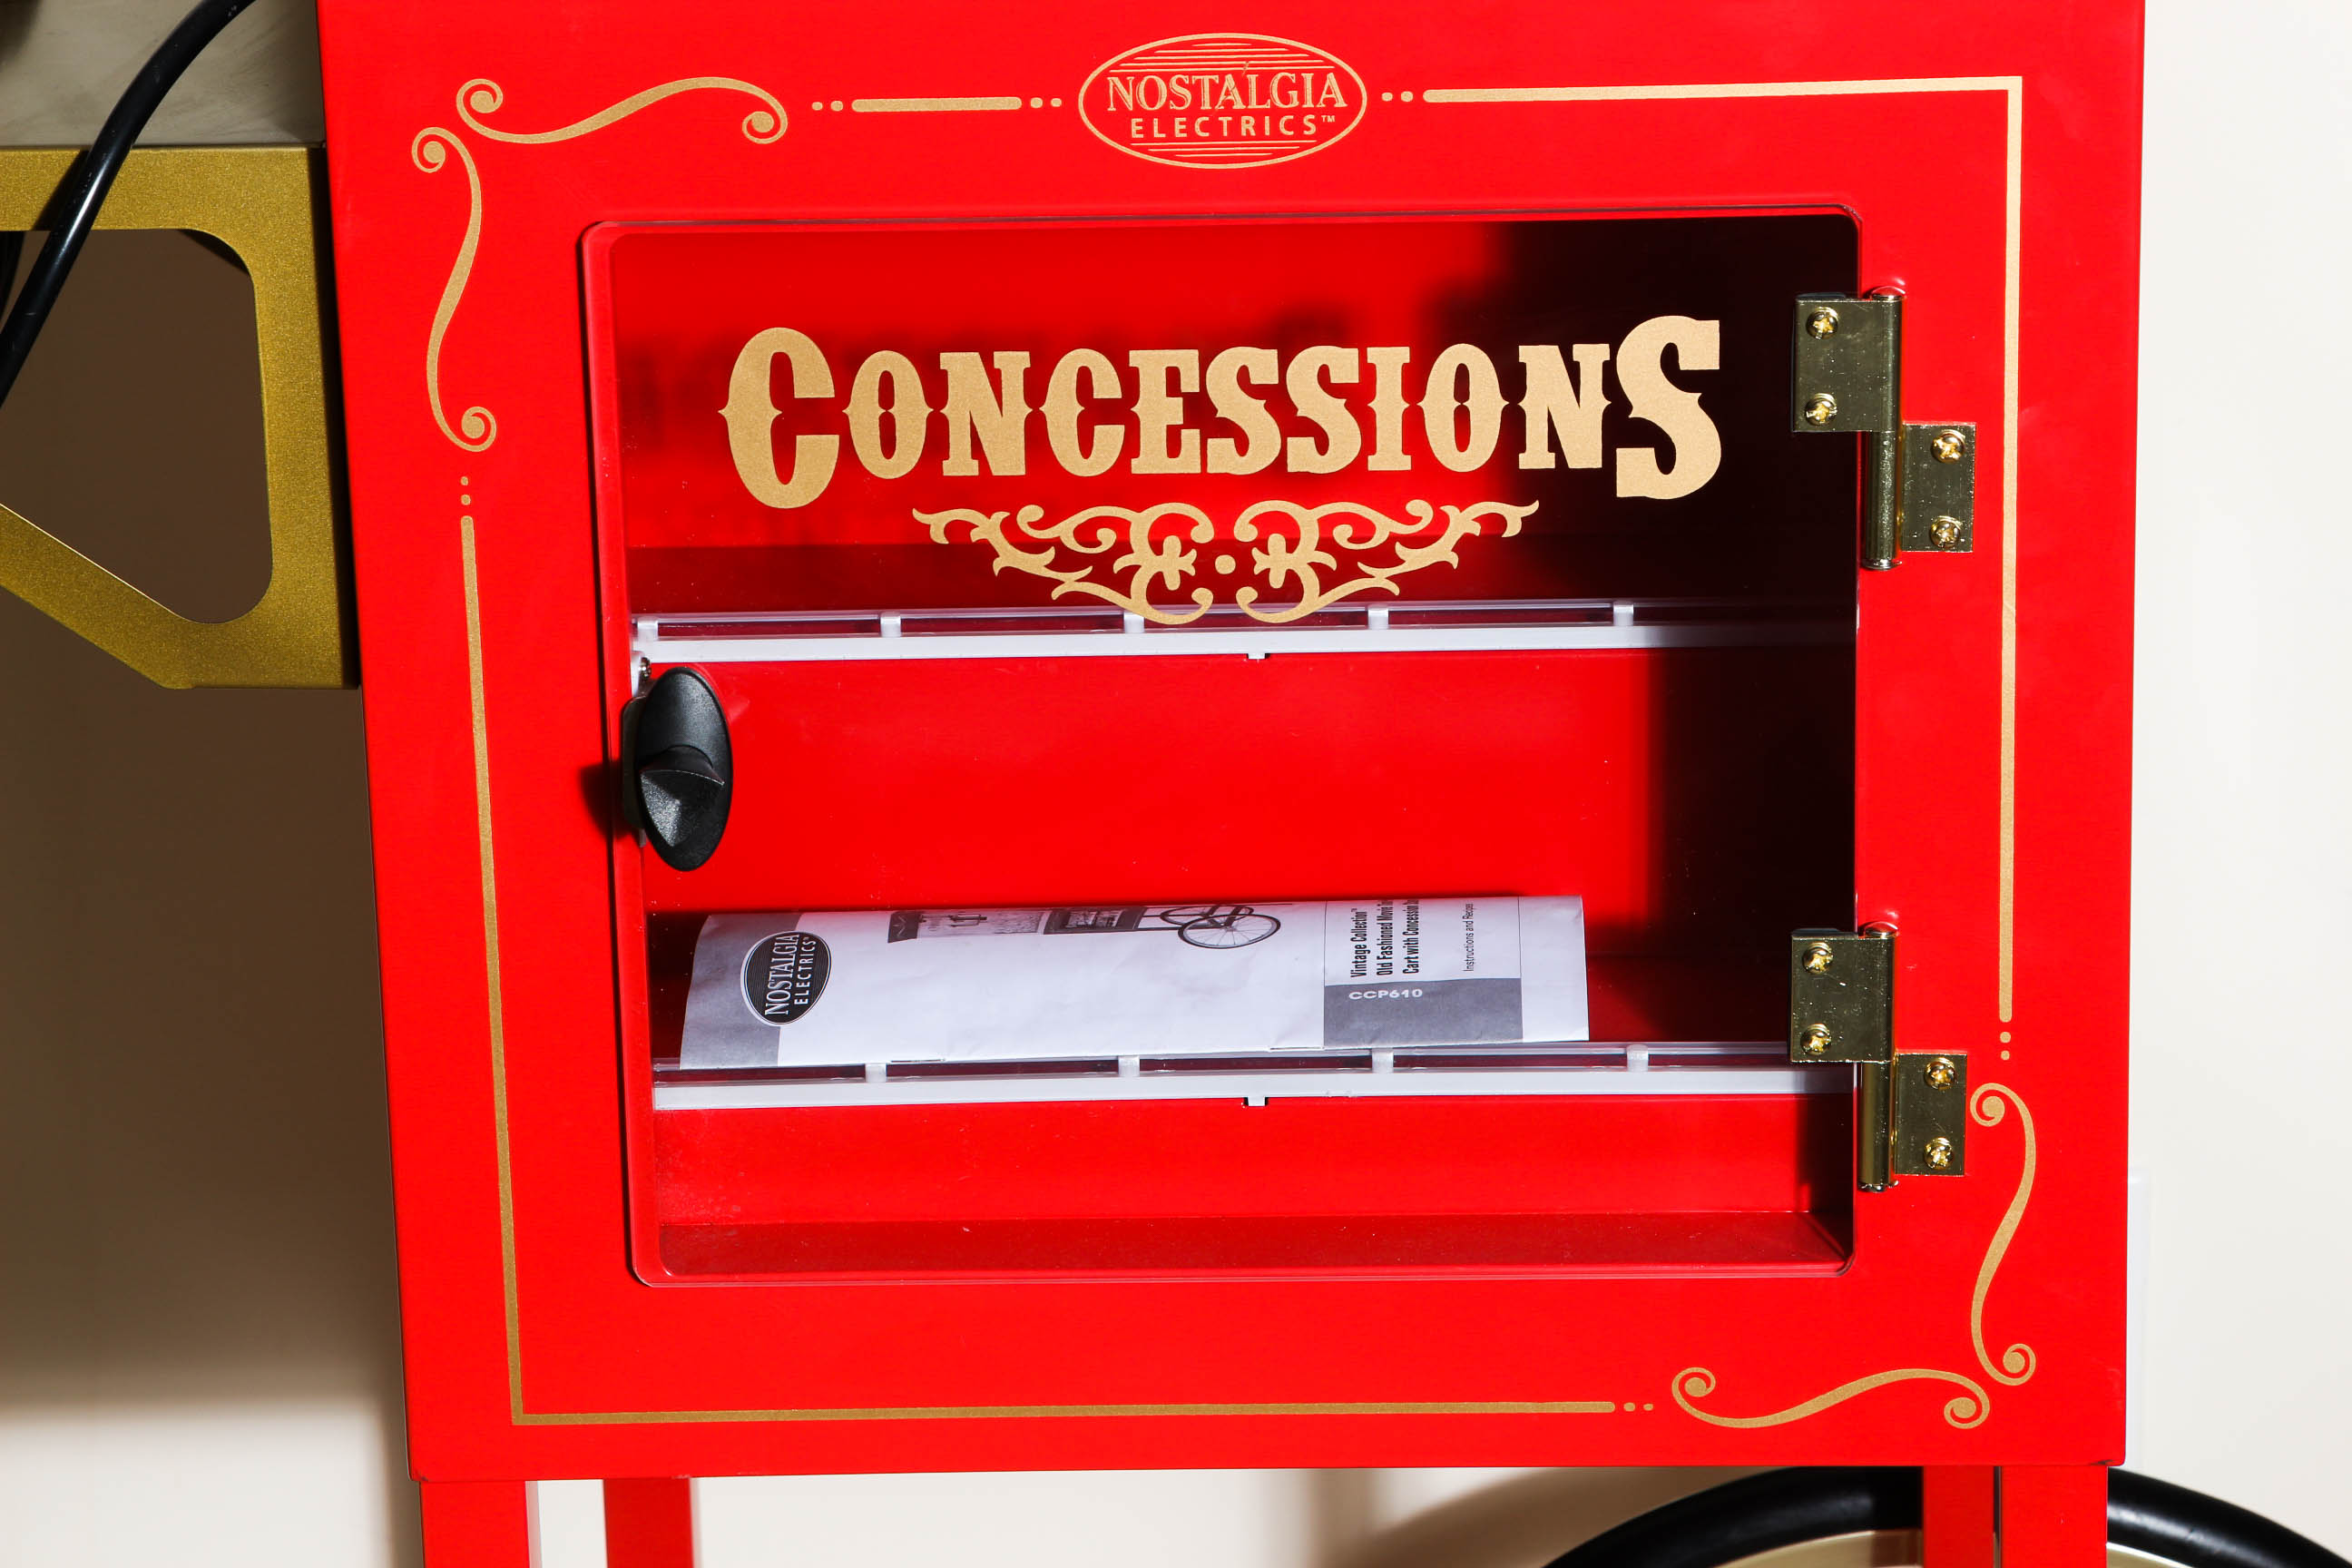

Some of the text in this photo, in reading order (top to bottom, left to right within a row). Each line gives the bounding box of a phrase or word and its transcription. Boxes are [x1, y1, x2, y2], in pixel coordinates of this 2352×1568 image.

[1107, 72, 1348, 111] NOSTALGIA
[1462, 920, 1475, 932] and
[1377, 922, 1393, 960] Fashioned
[1402, 937, 1419, 955] with
[1462, 932, 1475, 972] Instructions
[1350, 944, 1371, 977] Vintage
[1377, 962, 1393, 975] Old
[1402, 956, 1419, 974] Cart
[764, 934, 799, 1015] NOSTALGIA
[1348, 988, 1423, 1000] CCP610
